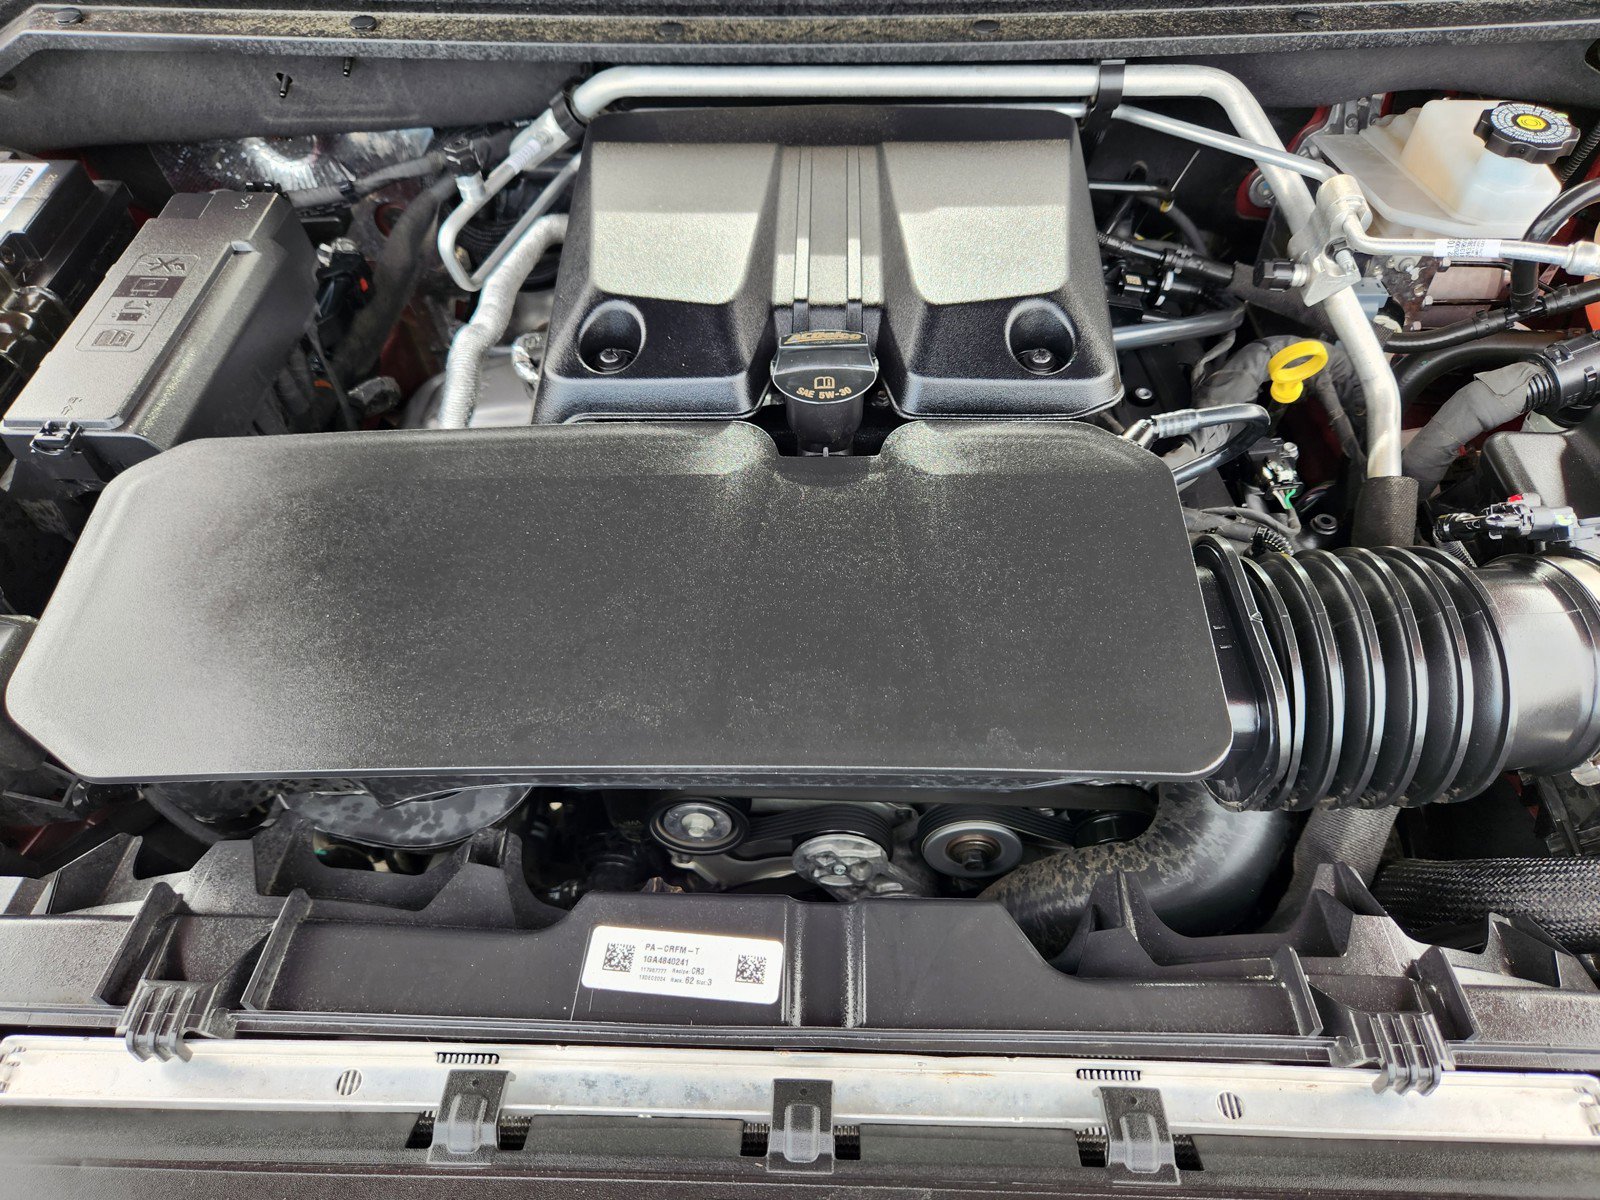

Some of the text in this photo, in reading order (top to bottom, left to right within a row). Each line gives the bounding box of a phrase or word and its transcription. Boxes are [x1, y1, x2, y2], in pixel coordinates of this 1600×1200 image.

[796, 386, 852, 399] SAE 5W-30
[643, 955, 689, 966] 1GA4840241
[691, 967, 705, 975] CR3
[685, 976, 695, 985] 62
